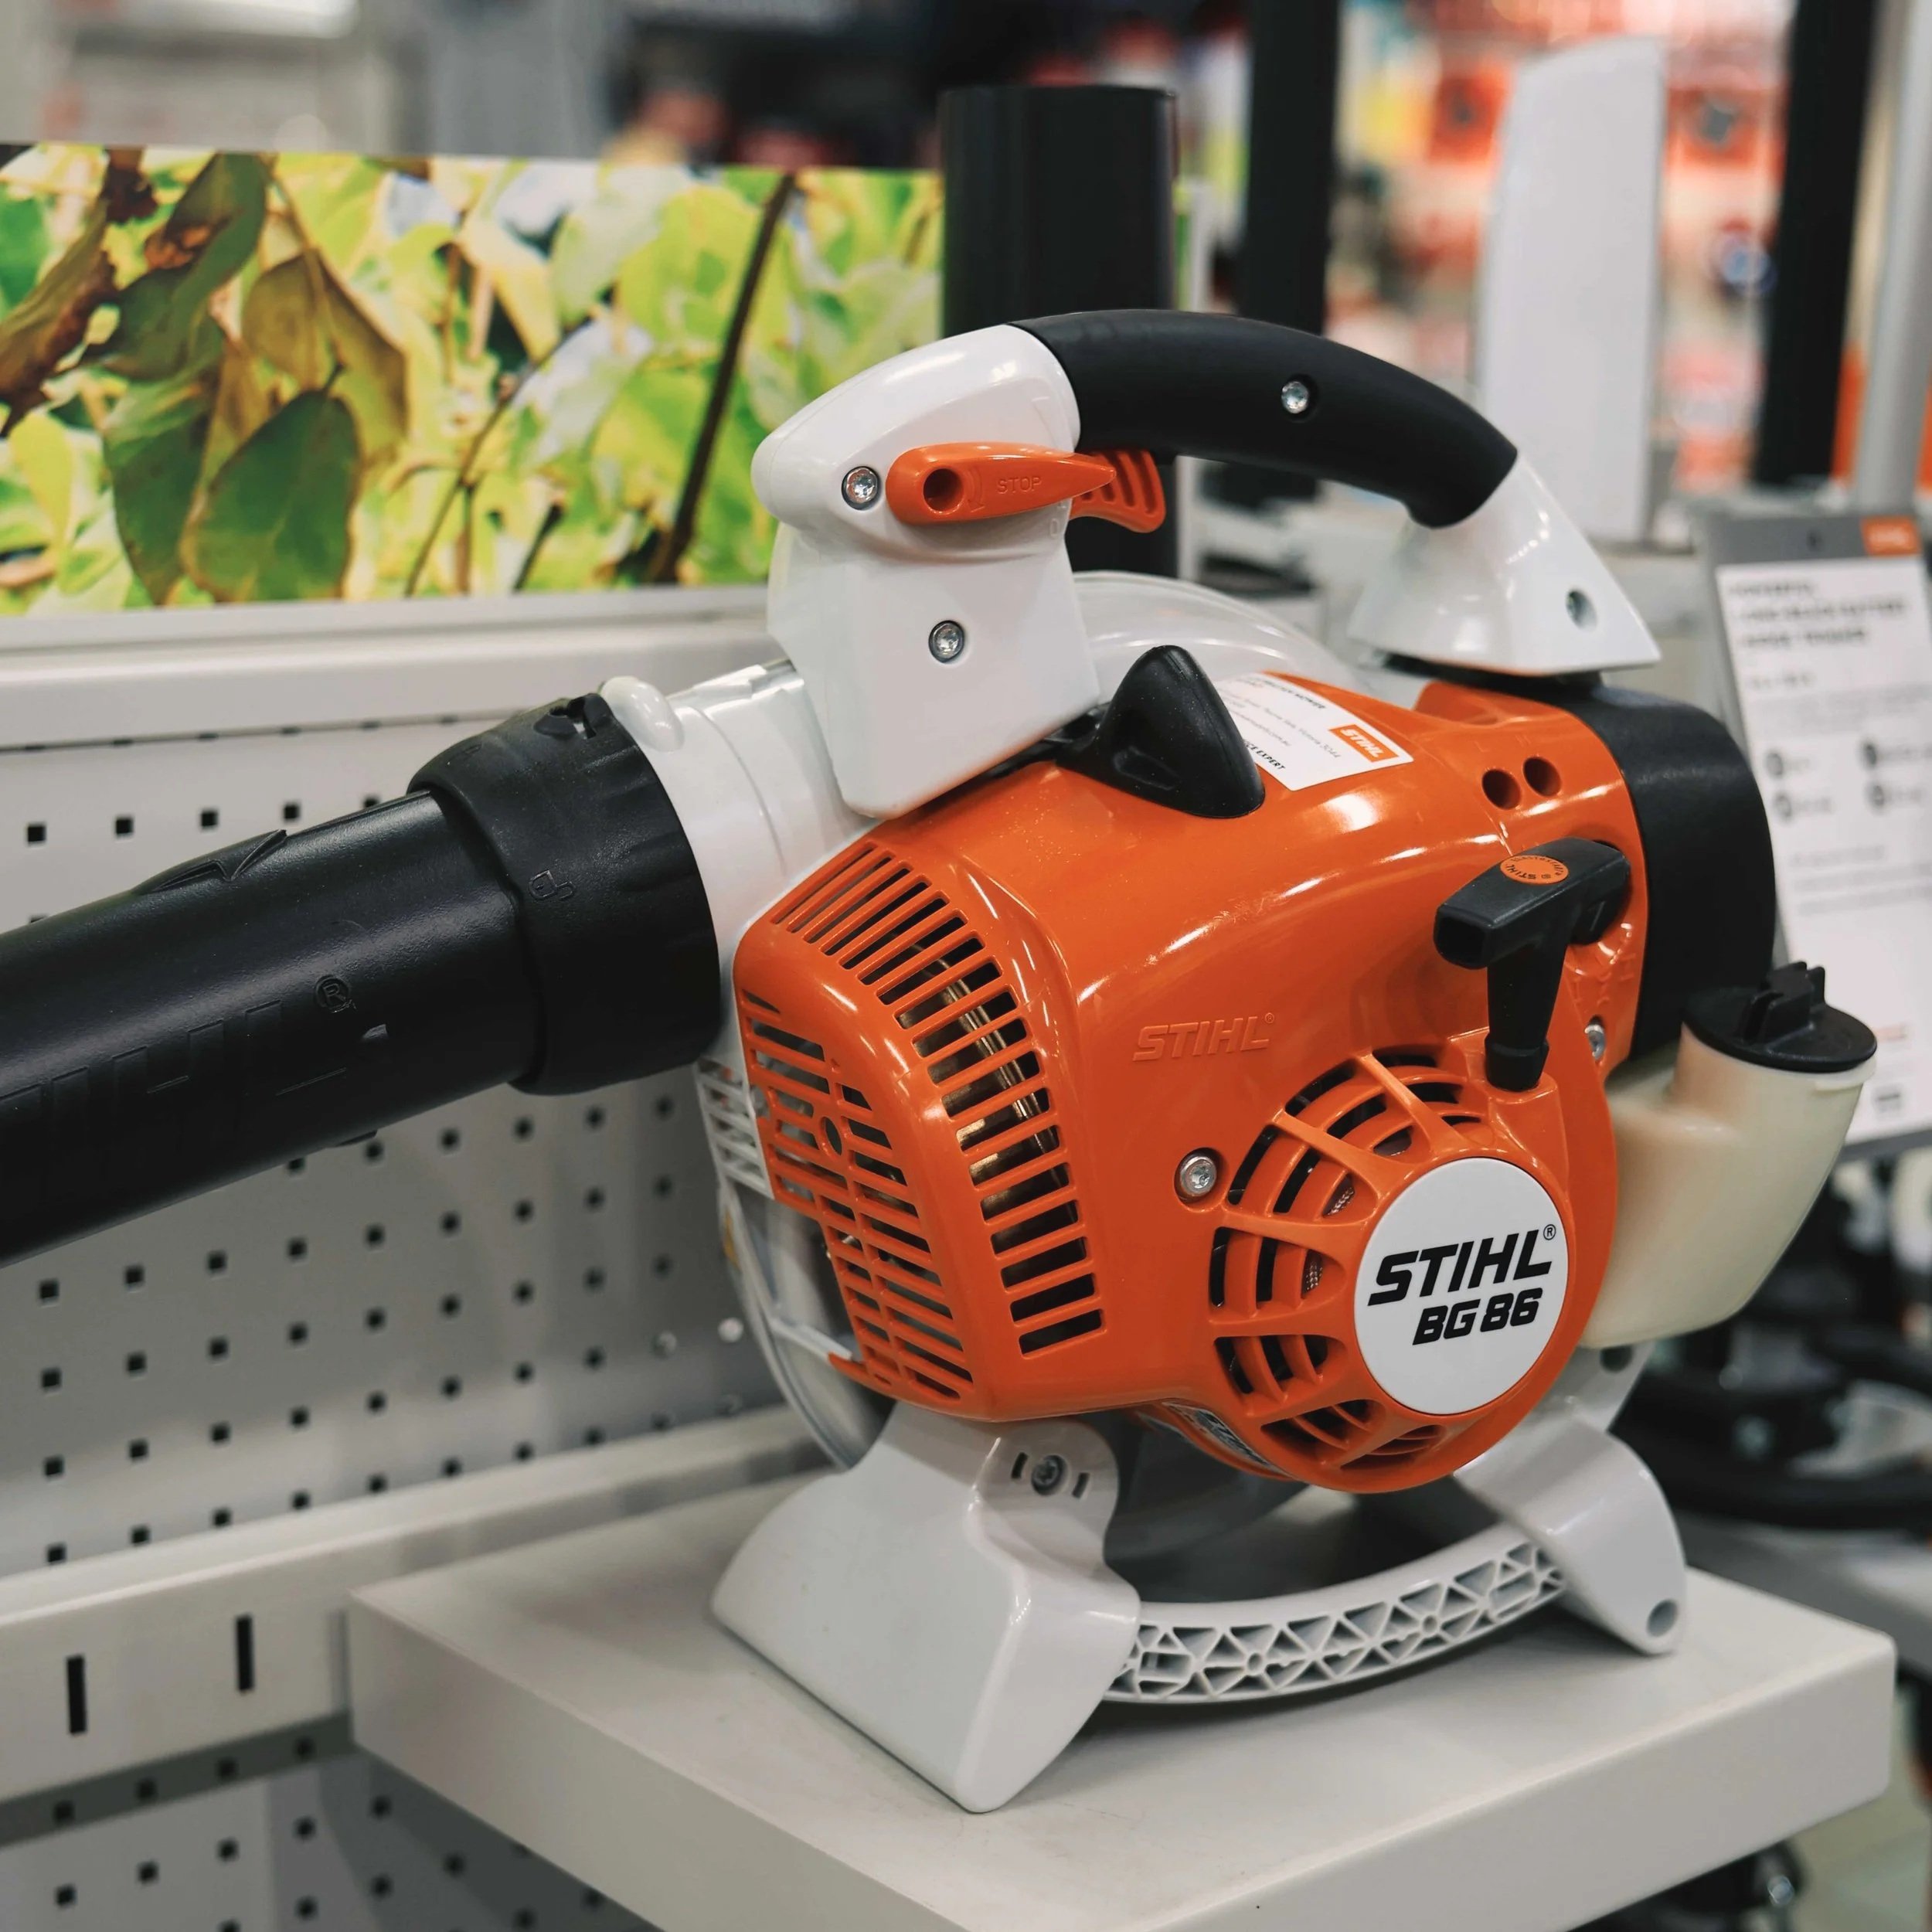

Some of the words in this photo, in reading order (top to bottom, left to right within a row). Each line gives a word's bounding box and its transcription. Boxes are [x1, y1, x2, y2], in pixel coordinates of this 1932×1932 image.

[997, 476, 1043, 495] STOP
[1339, 728, 1386, 758] STIHL
[1256, 750, 1286, 769] EXPERT
[1505, 863, 1536, 879] STIHL
